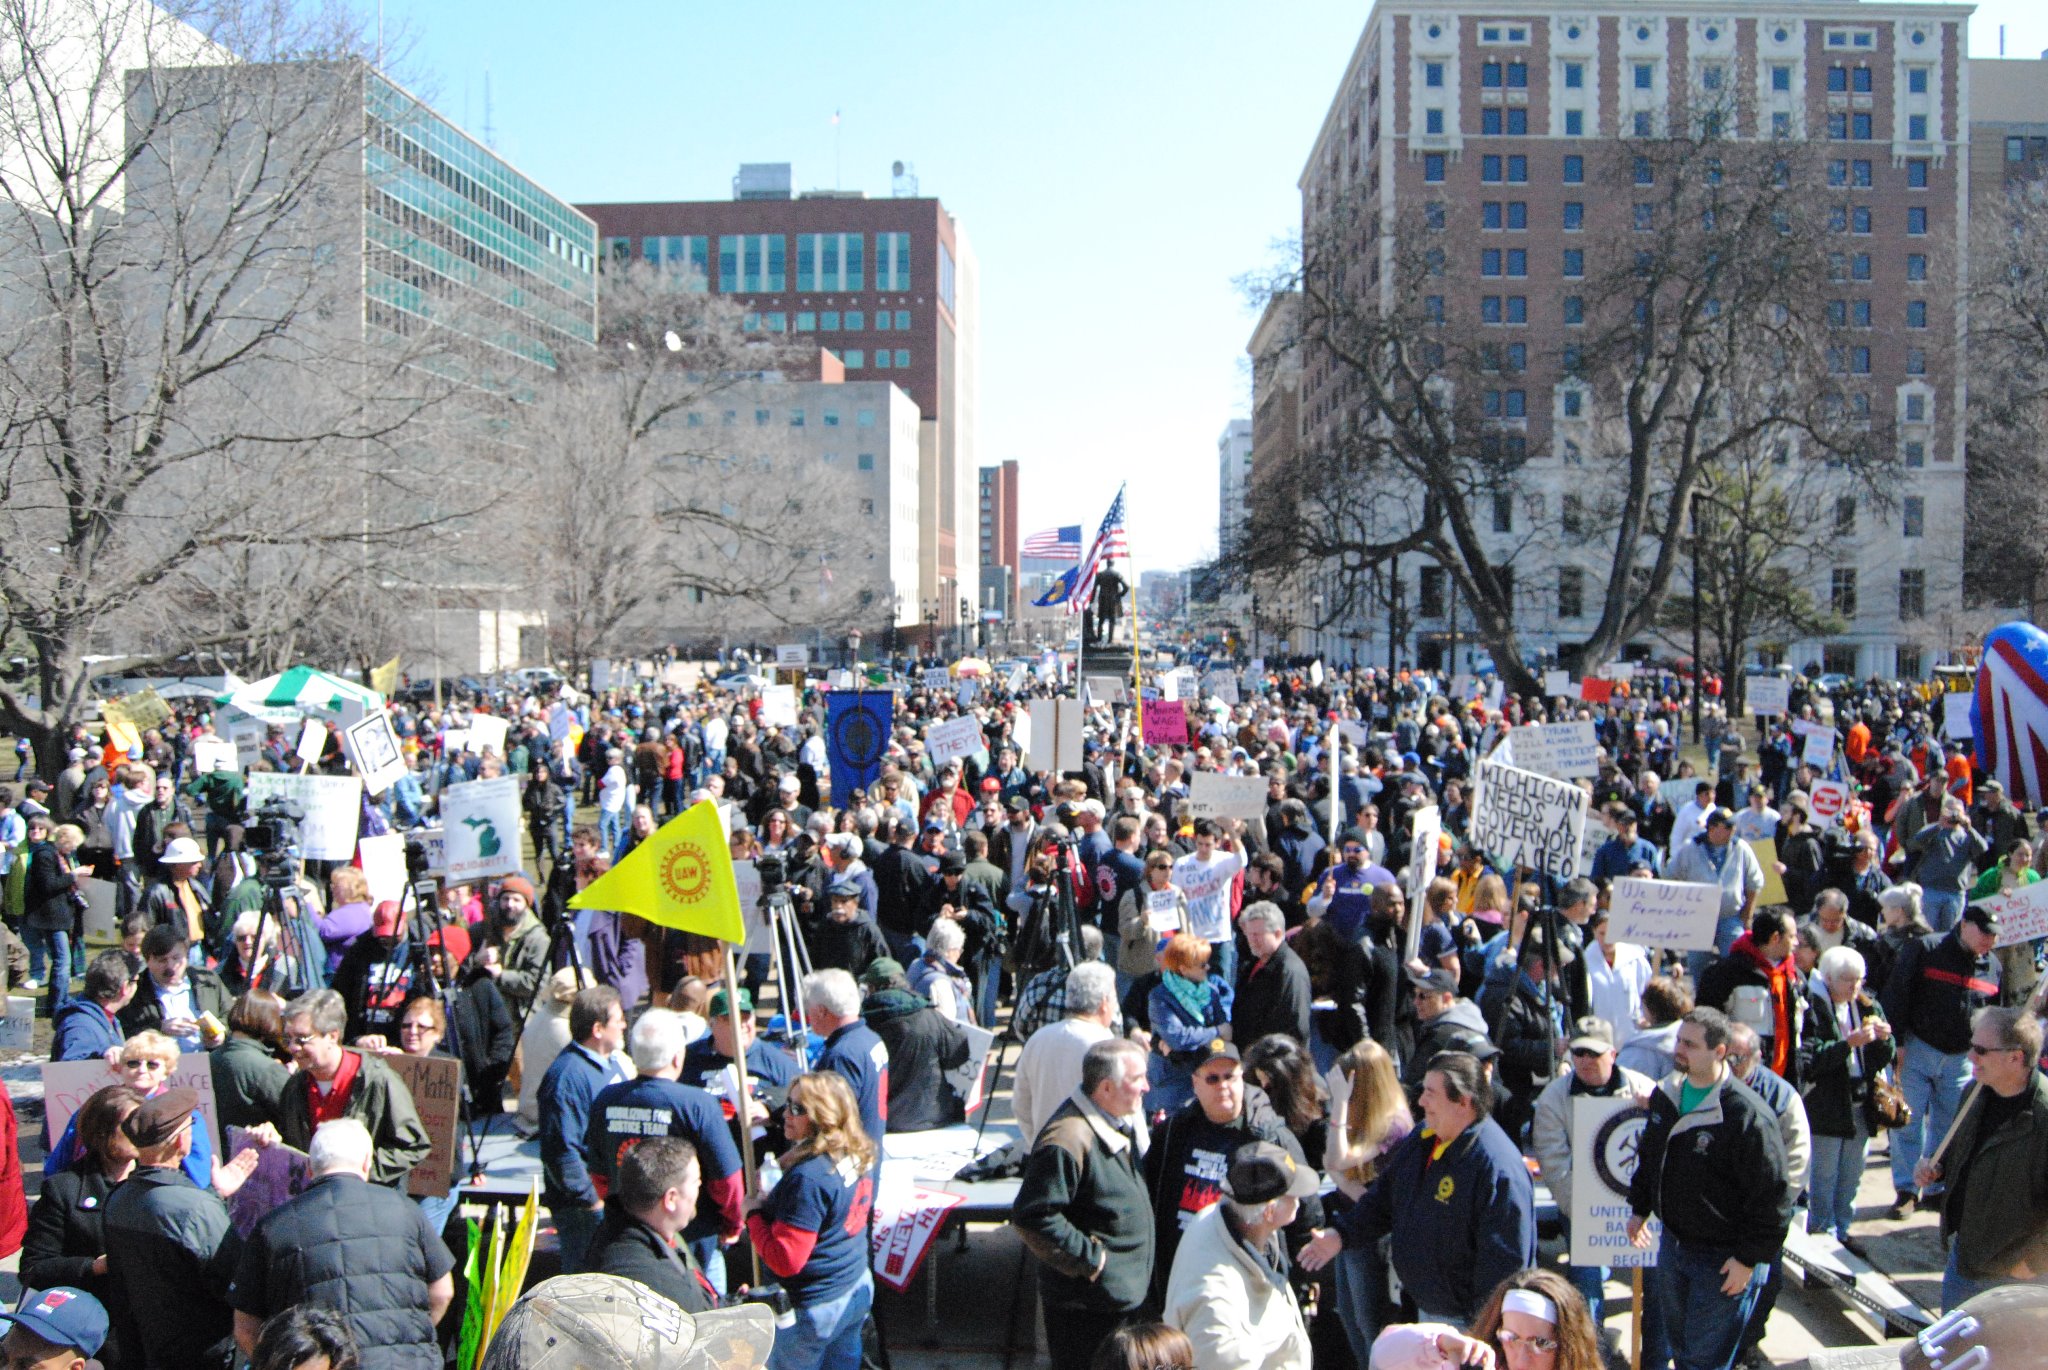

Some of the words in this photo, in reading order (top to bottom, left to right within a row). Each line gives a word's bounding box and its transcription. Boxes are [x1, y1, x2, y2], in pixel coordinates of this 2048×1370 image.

[936, 734, 977, 754] THEY?
[1481, 763, 1581, 811] MICHIGAN
[1484, 784, 1545, 823] NEEDS
[1559, 811, 1571, 833] A
[1477, 803, 1577, 857] GOVERNOR
[1475, 827, 1509, 856] NOT
[1514, 843, 1526, 866] A
[1534, 848, 1573, 878] CEO
[675, 867, 697, 880] UAW
[607, 1120, 641, 1133] JUSTICE
[643, 1122, 668, 1136] TEAM
[1590, 1206, 1633, 1217] UNITE
[872, 1225, 891, 1253] uts
